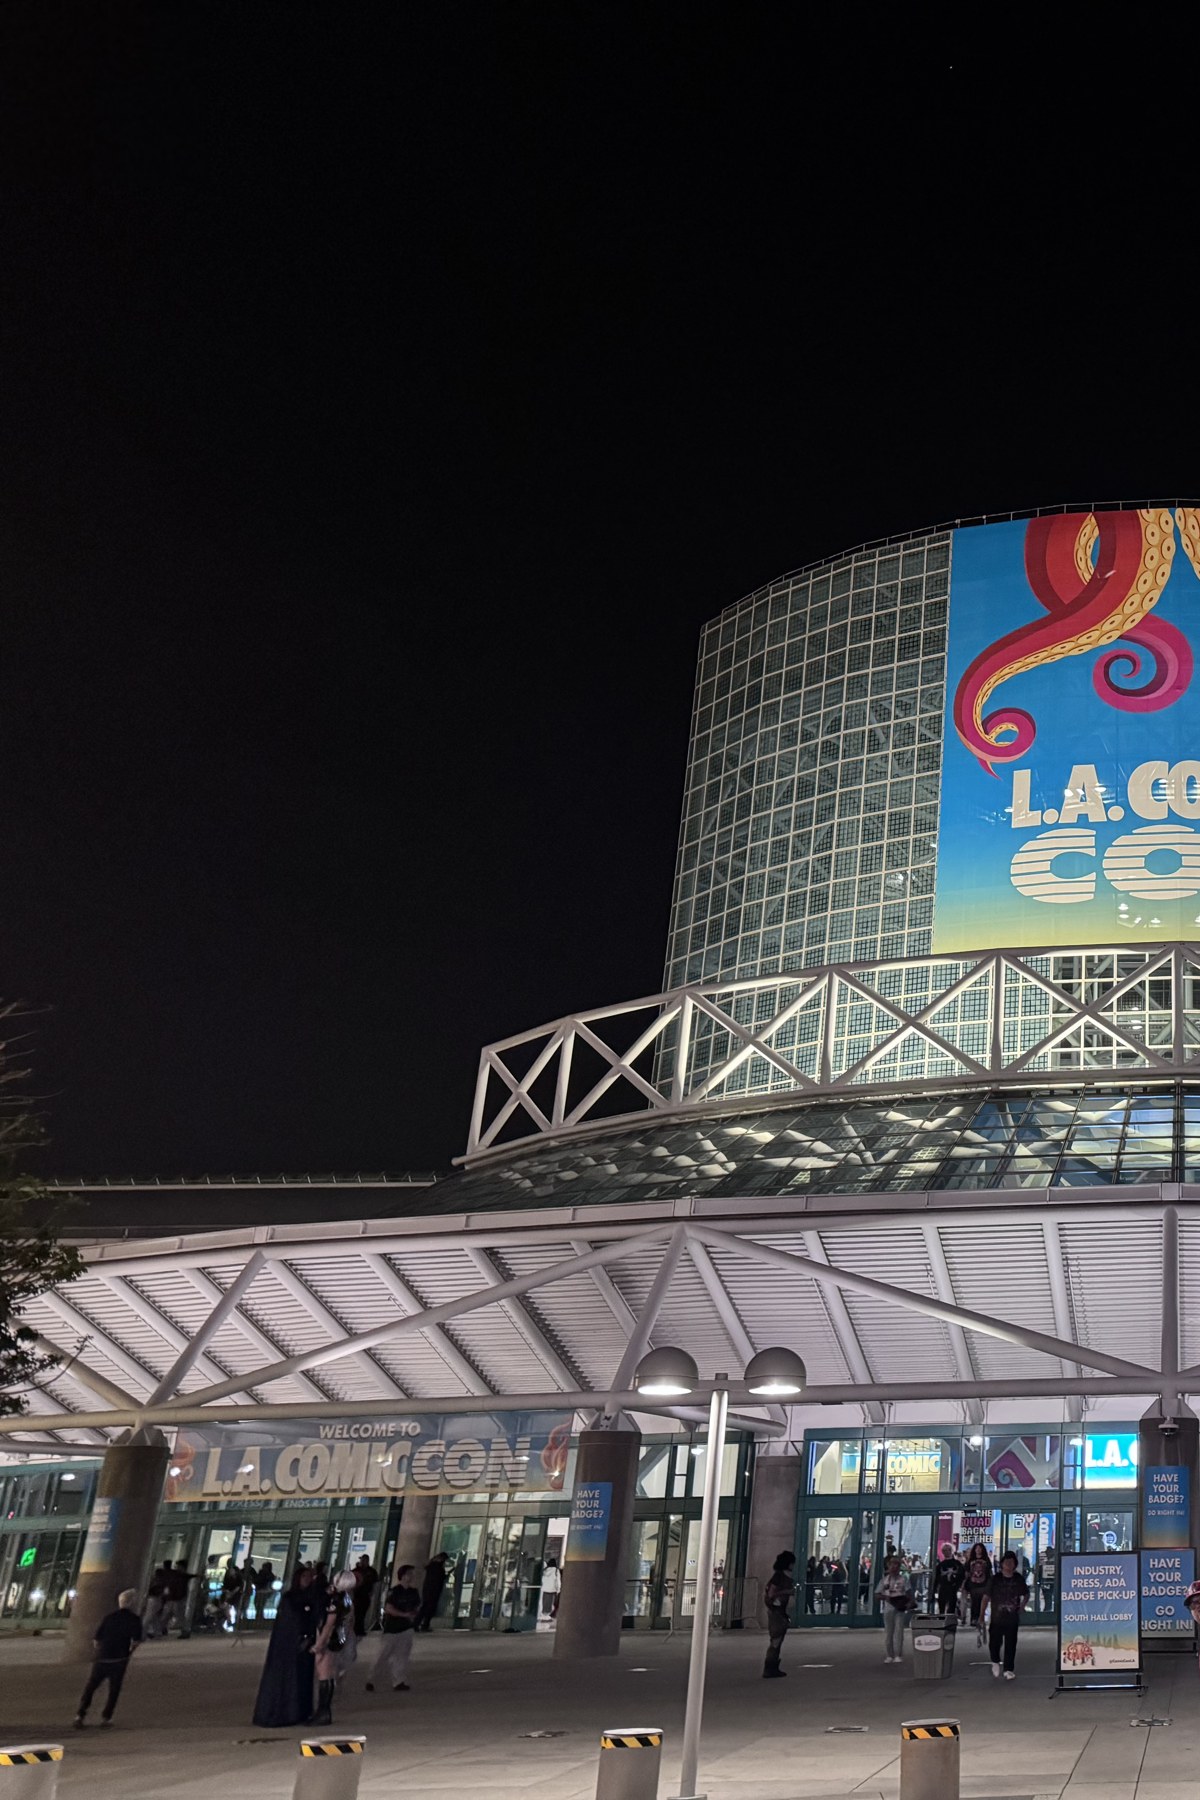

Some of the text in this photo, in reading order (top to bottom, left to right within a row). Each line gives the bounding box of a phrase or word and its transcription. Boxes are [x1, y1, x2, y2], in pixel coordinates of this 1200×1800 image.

[1011, 764, 1124, 828] L.A.
[319, 1422, 421, 1439] WELCOME TO
[202, 1437, 531, 1496] L.A. COMIC CON
[1153, 1473, 1179, 1482] HAVE
[1153, 1484, 1179, 1493] YOUR
[577, 1490, 600, 1499] HAVE
[1148, 1494, 1184, 1504] BADGE?
[576, 1500, 600, 1509] YOUR
[1149, 1558, 1181, 1568] HAVE
[1073, 1566, 1124, 1576] INDUSTRY,
[1148, 1572, 1182, 1582] YOUR
[1071, 1578, 1126, 1588] PRESS, ADA
[1061, 1591, 1136, 1600] BADGE PICK-UP
[1142, 1586, 1188, 1596] BADGE?
[1155, 1605, 1175, 1616] GO
[1064, 1614, 1089, 1622] SOUTH
[1110, 1613, 1133, 1621] LOBBY
[1176, 1620, 1193, 1630] IN!
